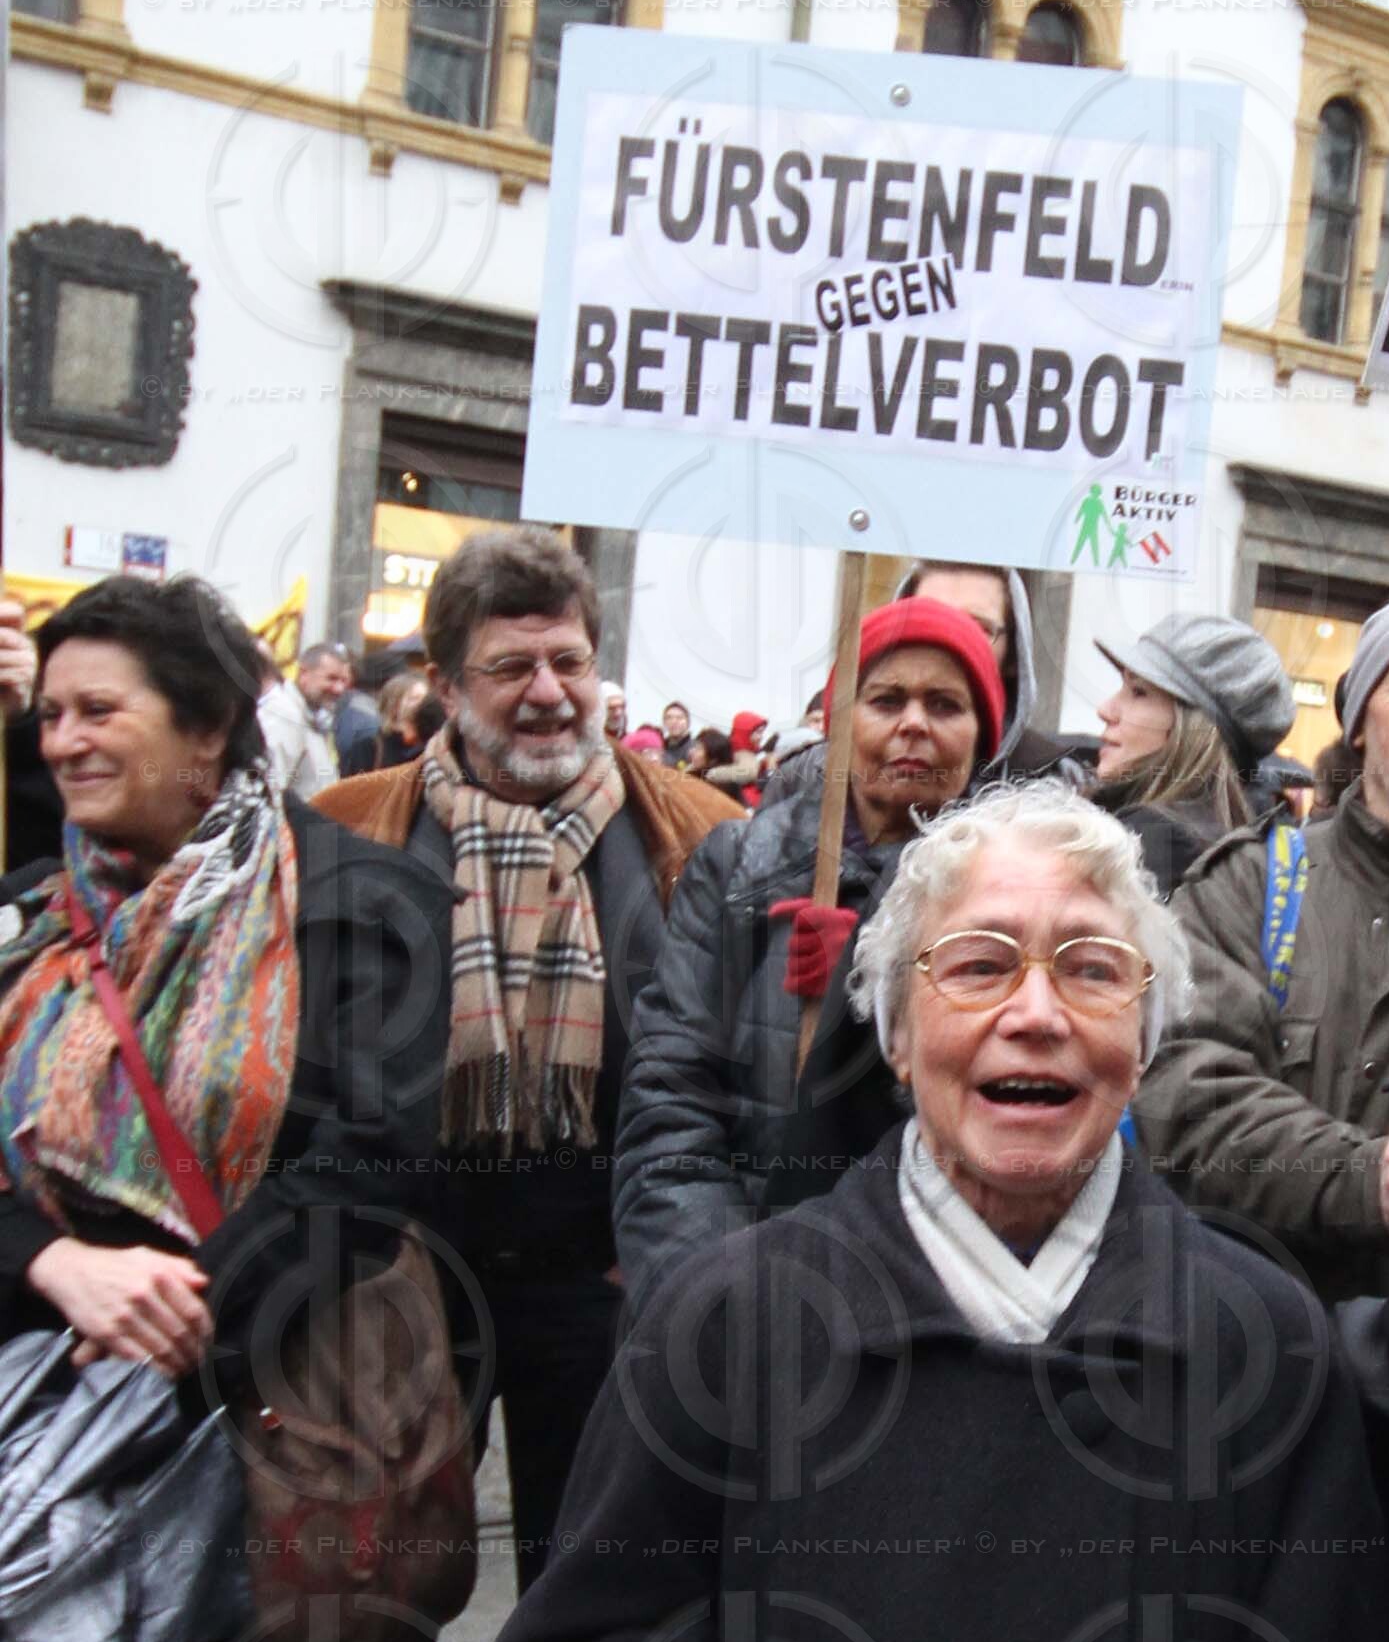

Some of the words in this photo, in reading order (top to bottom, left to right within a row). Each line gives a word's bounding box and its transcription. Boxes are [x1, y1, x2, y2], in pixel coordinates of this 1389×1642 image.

[610, 118, 1172, 287] FÜRSTENFELD
[814, 257, 958, 333] GEGEN
[570, 304, 1186, 463] BETTELVERBOT
[1112, 503, 1178, 522] AKTIV
[1114, 485, 1198, 507] BÜRGER
